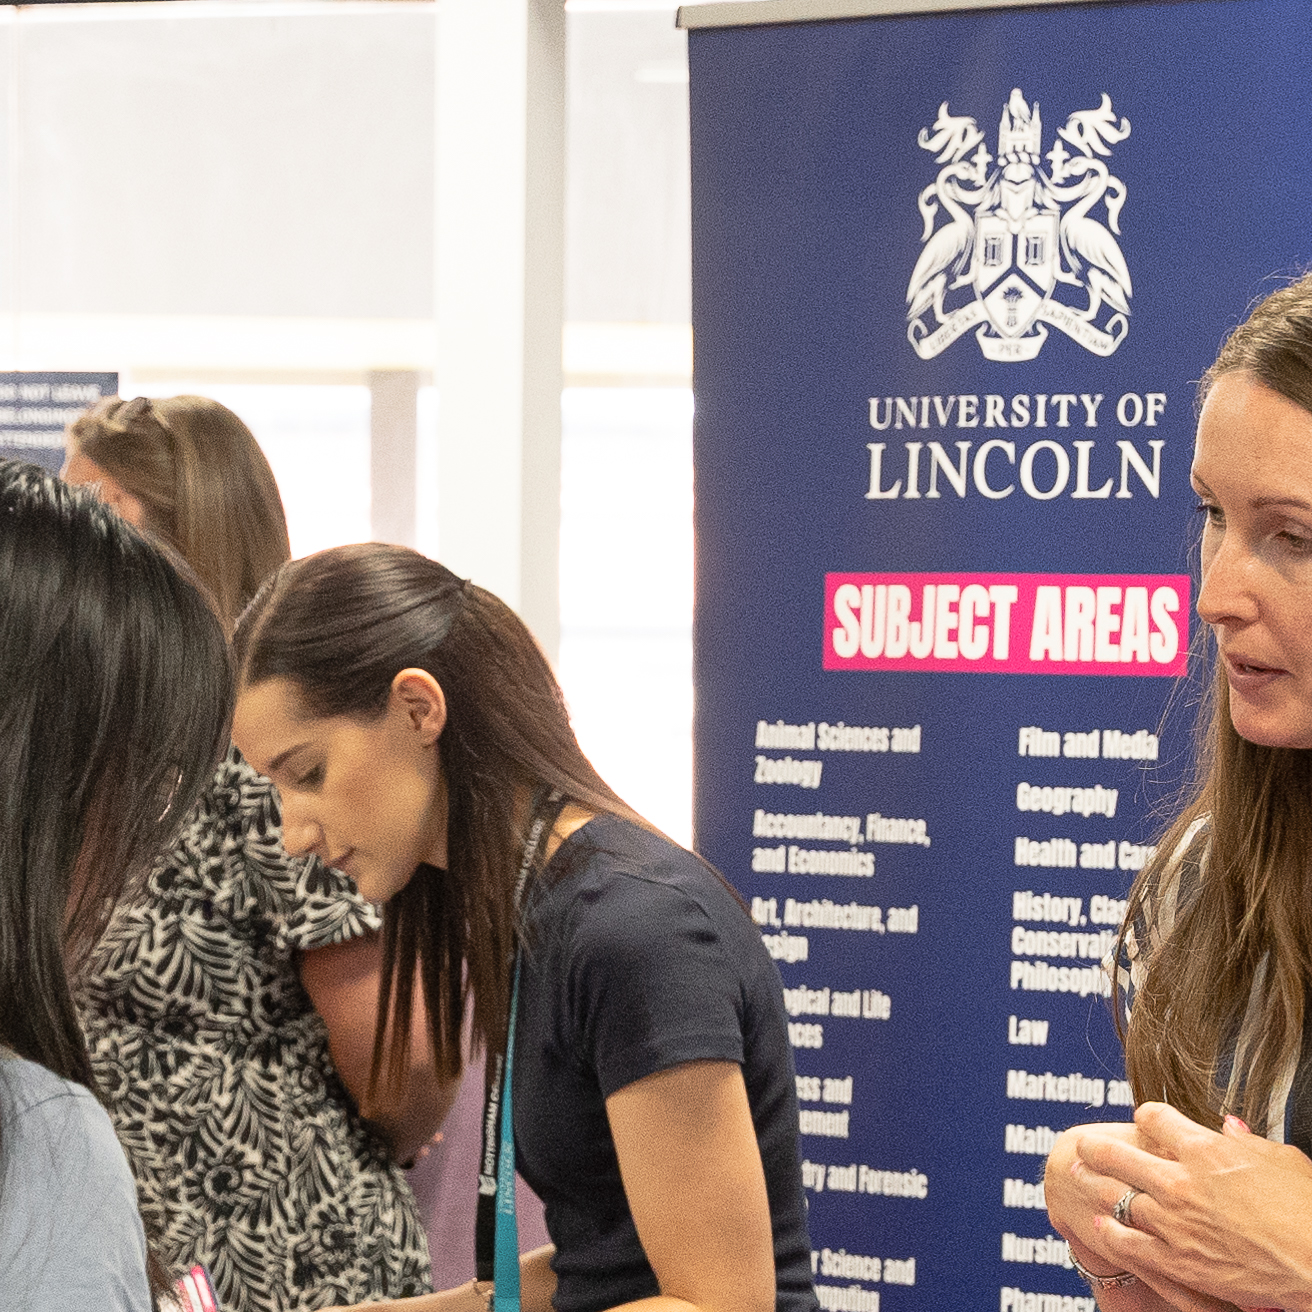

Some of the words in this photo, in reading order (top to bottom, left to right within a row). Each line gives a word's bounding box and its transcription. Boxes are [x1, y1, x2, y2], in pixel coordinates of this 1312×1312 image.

[868, 394, 1102, 430] UNIVERSITY
[1117, 393, 1167, 427] OF
[865, 439, 1165, 500] LINCOLN
[832, 584, 1018, 660] SUBJECT
[1030, 585, 1179, 664] AREAS
[755, 721, 815, 750] Animal
[817, 722, 889, 752] Sciences
[890, 725, 921, 753] and
[1019, 726, 1060, 758] Film
[1063, 728, 1100, 759] and
[1103, 729, 1158, 760] Media
[754, 755, 822, 789] Zoology
[1016, 782, 1118, 817] Geography
[866, 813, 931, 847] Finance,
[752, 845, 786, 873] and
[789, 847, 874, 877] Economics
[1015, 837, 1077, 868] Health
[1080, 841, 1116, 870] and
[887, 906, 918, 933] and
[1013, 891, 1087, 926] History,
[762, 931, 808, 963] esign
[831, 989, 860, 1017] and
[1008, 1015, 1049, 1046] Law
[822, 1075, 852, 1105] and
[1006, 1069, 1104, 1107] Marketing
[1107, 1077, 1134, 1106] an
[799, 1109, 849, 1138] ement
[827, 1164, 857, 1192] and
[859, 1164, 928, 1199] Forensic
[820, 1249, 882, 1281] Science
[884, 1257, 916, 1286] and
